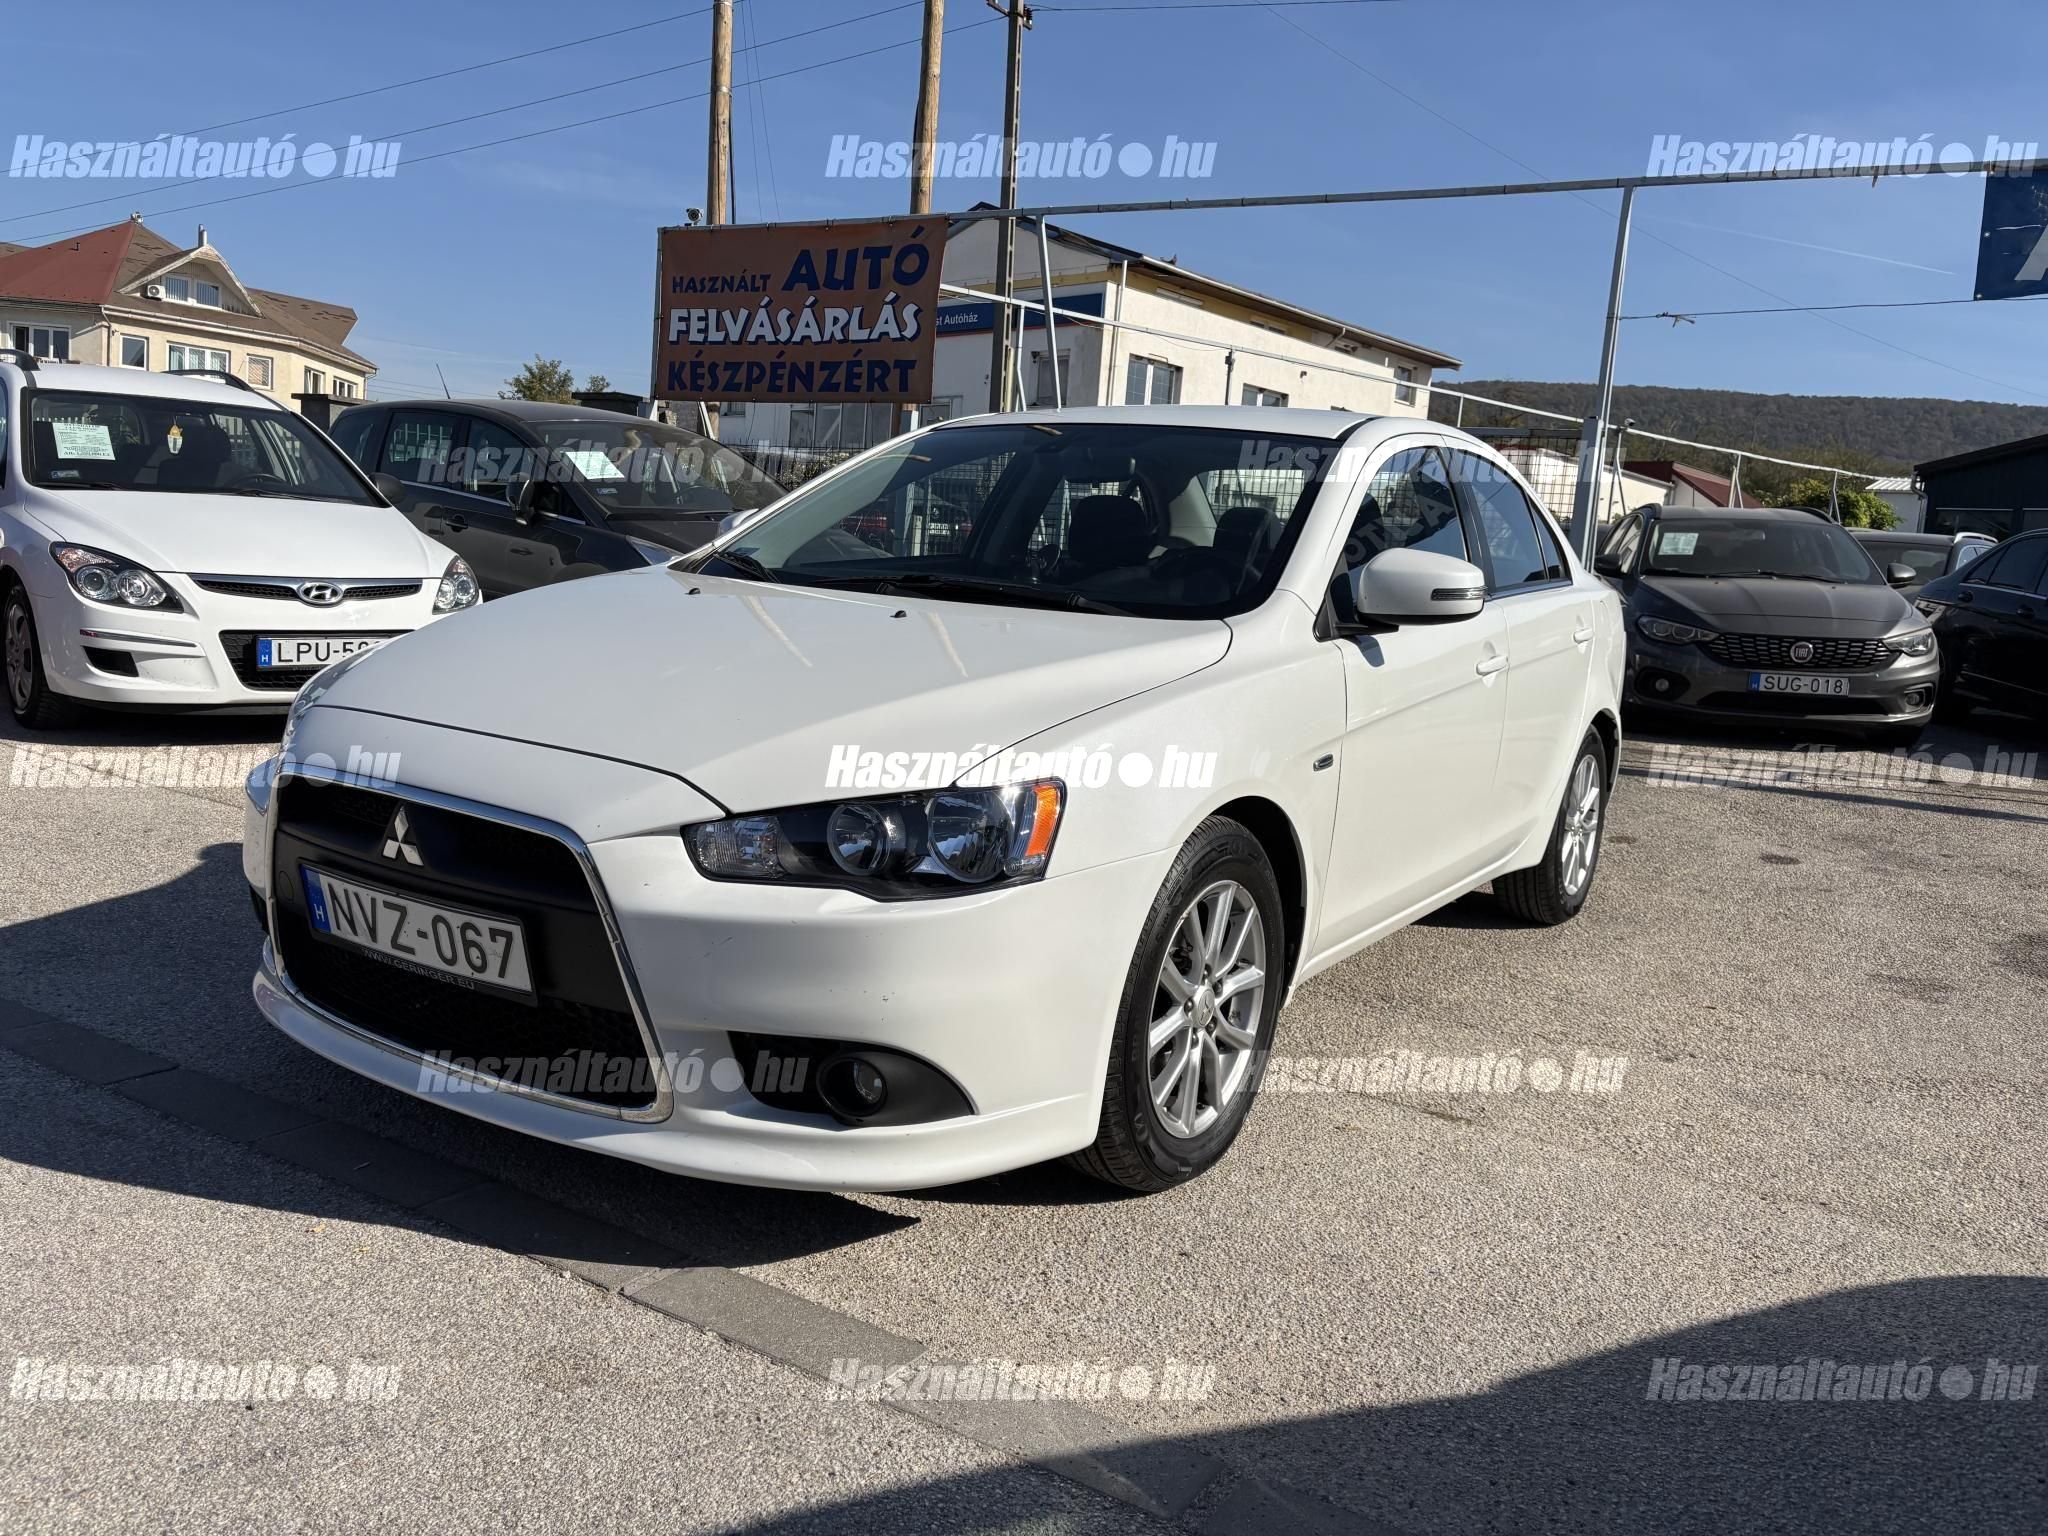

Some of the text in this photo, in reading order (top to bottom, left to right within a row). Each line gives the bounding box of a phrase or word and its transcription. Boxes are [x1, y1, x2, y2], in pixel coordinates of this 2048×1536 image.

[672, 225, 930, 293] HASZNÁLT AUTÓ
[668, 291, 923, 345] FELVÁSÁRLÁS
[944, 313, 978, 325] Autóház
[668, 349, 917, 392] KÉSZPÉNZÉRT
[1795, 648, 1809, 657] FIAT
[1764, 675, 1844, 694] SUG-018
[313, 882, 514, 979] H NVZ-067
